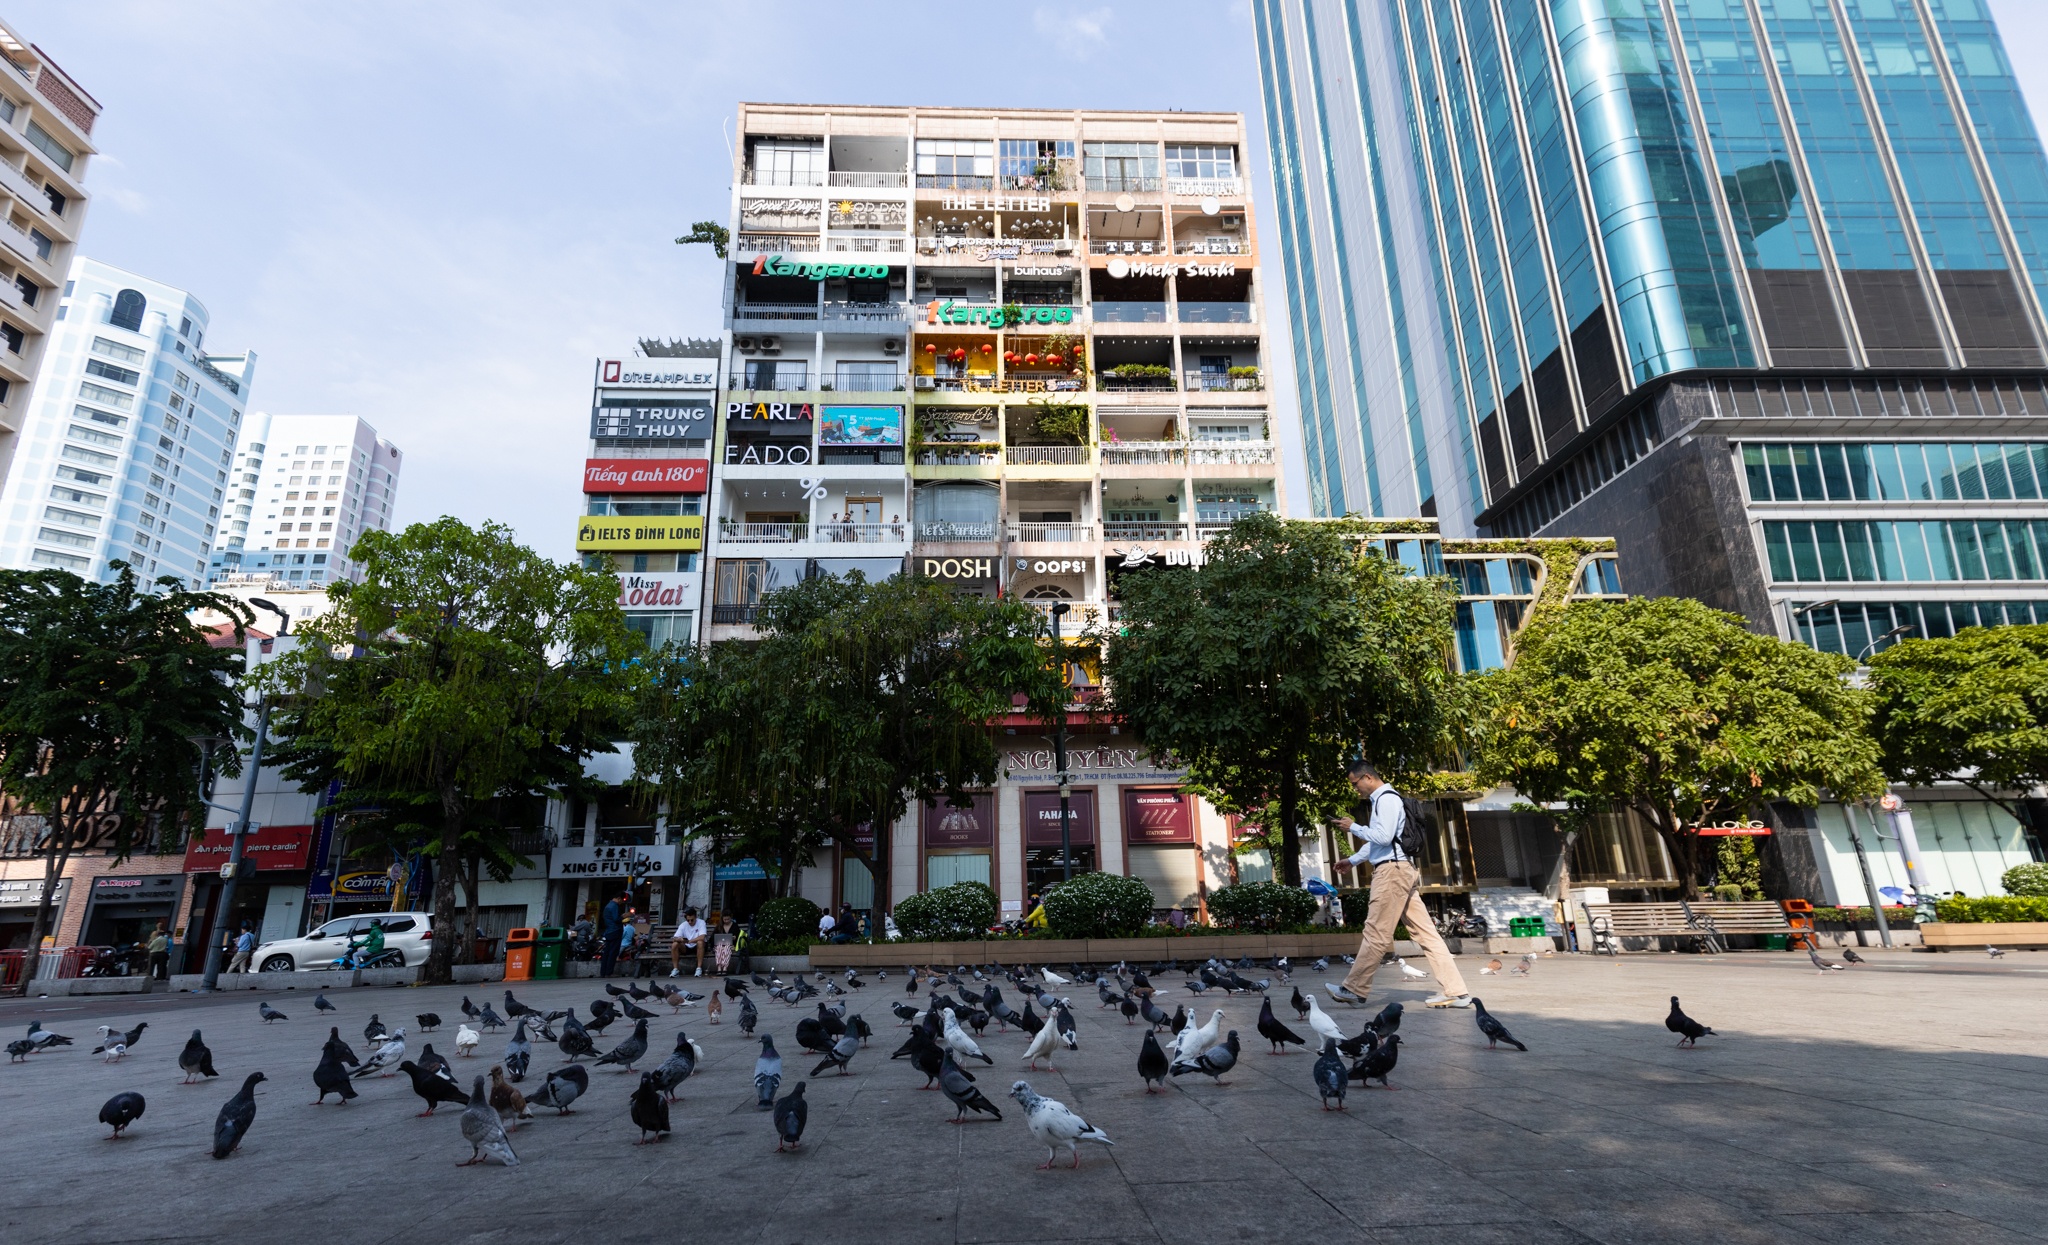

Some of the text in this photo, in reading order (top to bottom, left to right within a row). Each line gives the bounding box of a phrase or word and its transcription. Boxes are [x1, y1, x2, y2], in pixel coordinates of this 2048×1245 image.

[750, 199, 785, 213] Good
[880, 201, 905, 213] DAY
[942, 194, 1050, 212] THE LETTER
[996, 237, 1023, 246] NAIL
[1106, 241, 1153, 252] THE
[752, 254, 890, 282] Kangaroo
[1130, 260, 1235, 278] Michi Sushi
[926, 300, 1074, 329] Kangroo
[622, 372, 713, 384] DREAMPLEX
[989, 379, 1046, 393] LETTER
[636, 408, 706, 421] TRUNG
[726, 402, 813, 421] PEARLA
[849, 415, 858, 425] 5
[634, 424, 691, 437] THUY
[725, 445, 810, 465] FADO
[586, 465, 628, 486] Tiếng
[631, 468, 663, 482] anh
[665, 467, 694, 482] 180
[598, 526, 701, 540] IELTS ĐÌNH LONG
[924, 558, 991, 578] DOSH
[1033, 560, 1087, 574] OOPS!
[626, 576, 656, 589] Miss
[1713, 820, 1764, 830] LONG
[212, 844, 233, 855] phuo
[246, 843, 297, 853] pierre cardin
[562, 862, 598, 873] XING
[601, 862, 620, 872] FU
[109, 879, 142, 888] Kappa
